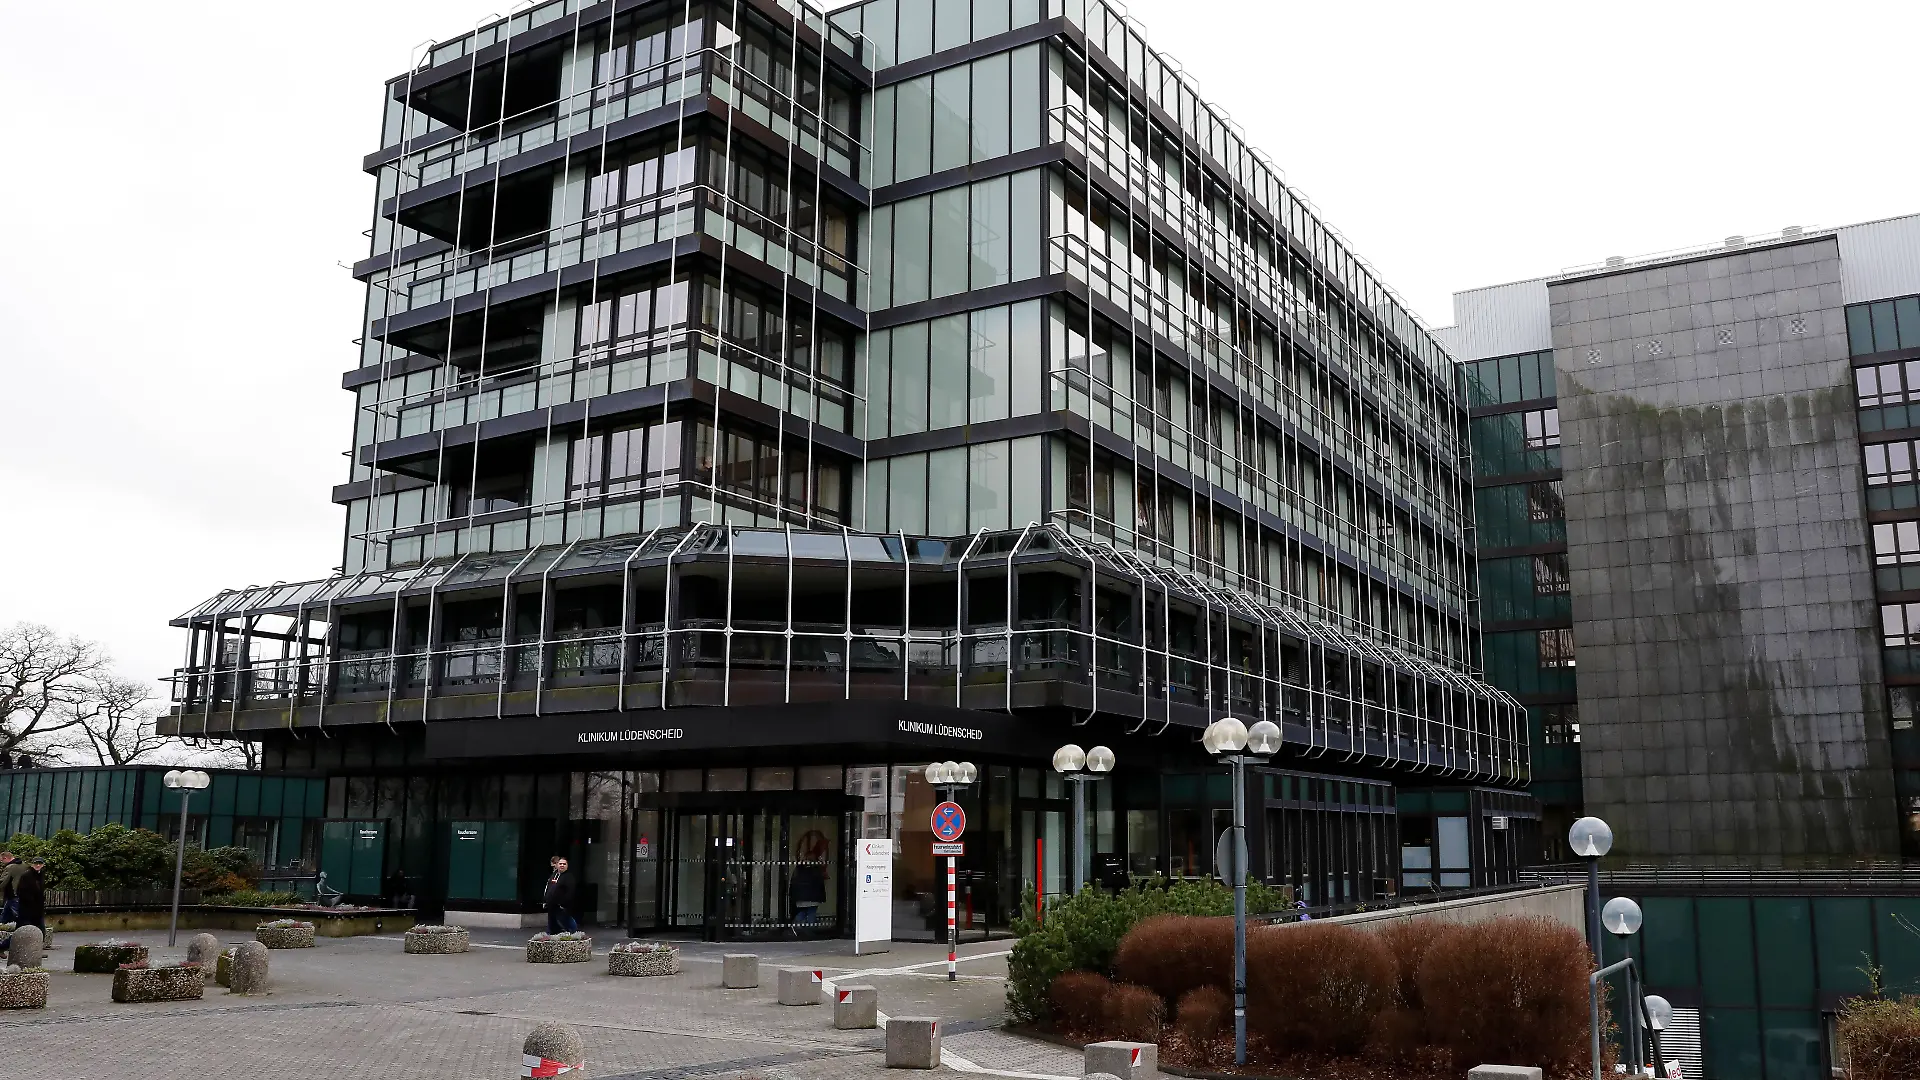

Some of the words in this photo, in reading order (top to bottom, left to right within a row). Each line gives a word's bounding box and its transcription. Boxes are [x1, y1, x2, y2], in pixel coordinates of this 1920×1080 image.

[577, 731, 618, 743] KLINIKUM
[619, 728, 683, 741] LÜDENSCHEID
[898, 719, 933, 735] KLINIKUM
[934, 723, 983, 740] LÜDENSCHEID
